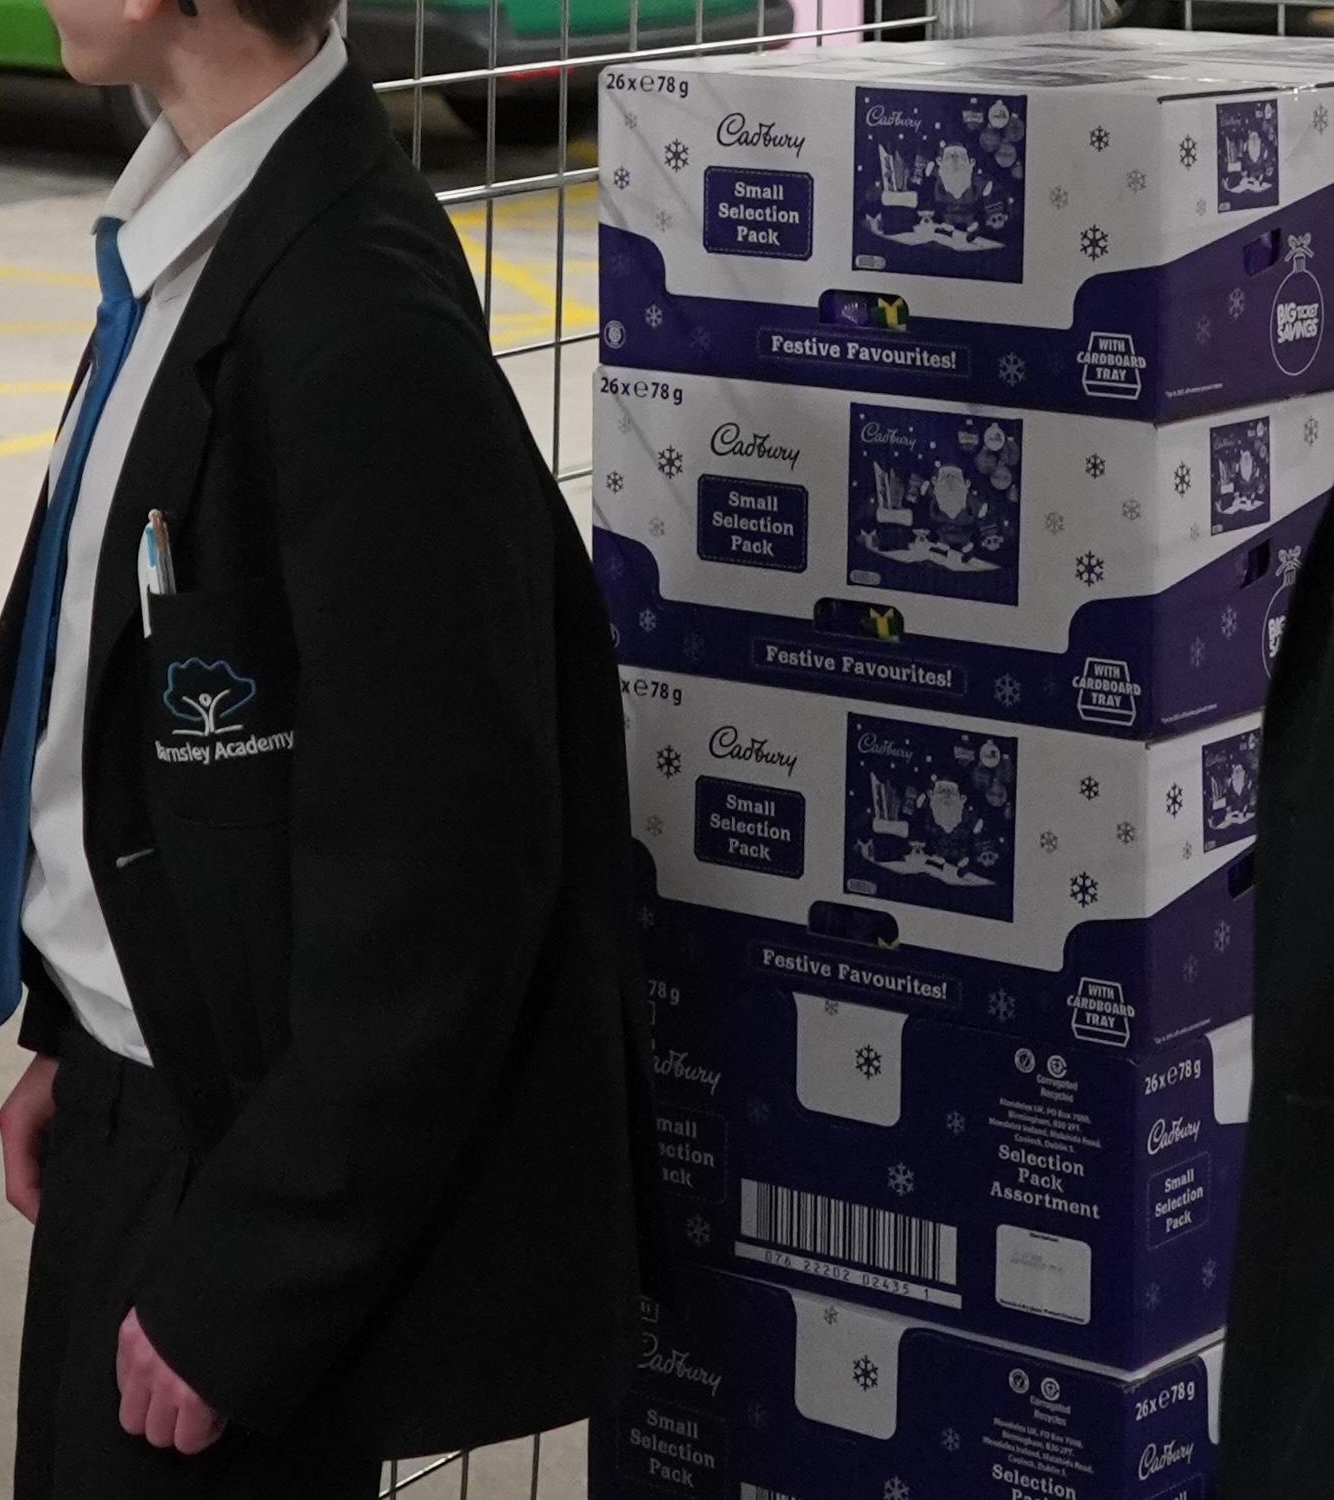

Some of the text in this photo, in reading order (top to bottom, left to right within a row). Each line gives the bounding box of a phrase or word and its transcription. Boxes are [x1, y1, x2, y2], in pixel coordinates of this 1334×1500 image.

[716, 112, 805, 158] Cadbury
[733, 180, 784, 201] Small
[718, 202, 800, 224] Selection
[736, 227, 780, 247] Pack
[1277, 302, 1297, 323] BIG
[1277, 316, 1318, 344] SAVINGS
[771, 334, 957, 370] Festive Favourites!
[1098, 337, 1126, 353] WITH
[1076, 351, 1147, 369] CARDBOARD
[1095, 366, 1127, 382] TRAY
[710, 422, 801, 470] Cadbury
[727, 490, 779, 512] Small
[711, 511, 795, 537] Selection
[730, 535, 774, 557] Pack
[765, 645, 953, 688] Festive Favourites!
[1094, 664, 1121, 679] WITH
[1071, 675, 1141, 697] CARDBOARD
[1091, 692, 1123, 708] TRAY
[214, 731, 295, 760] Academy
[708, 725, 797, 776] Cadbury
[856, 732, 914, 762] Cadbury
[725, 793, 776, 817] Small
[710, 812, 792, 842] Selection
[728, 838, 771, 861] Pack
[762, 948, 948, 1000] Festive Favourites!
[1087, 982, 1115, 1000] WITH
[1066, 993, 1136, 1018] CARDBOARD
[1085, 1011, 1116, 1029] TRAY
[655, 1115, 698, 1139] mall
[1147, 1116, 1201, 1155] Cadbury
[998, 1144, 1085, 1177] Selection
[1018, 1167, 1064, 1193] Pack
[1164, 1168, 1194, 1193] Small
[989, 1180, 1101, 1219] Assortment
[1155, 1186, 1204, 1217] Selection
[1166, 1209, 1192, 1233] Pack
[646, 1409, 699, 1439] Small
[629, 1427, 715, 1469] Selection
[1138, 1439, 1194, 1481] Cadbury
[649, 1457, 694, 1488] Pack
[991, 1463, 1077, 1500] Selection
